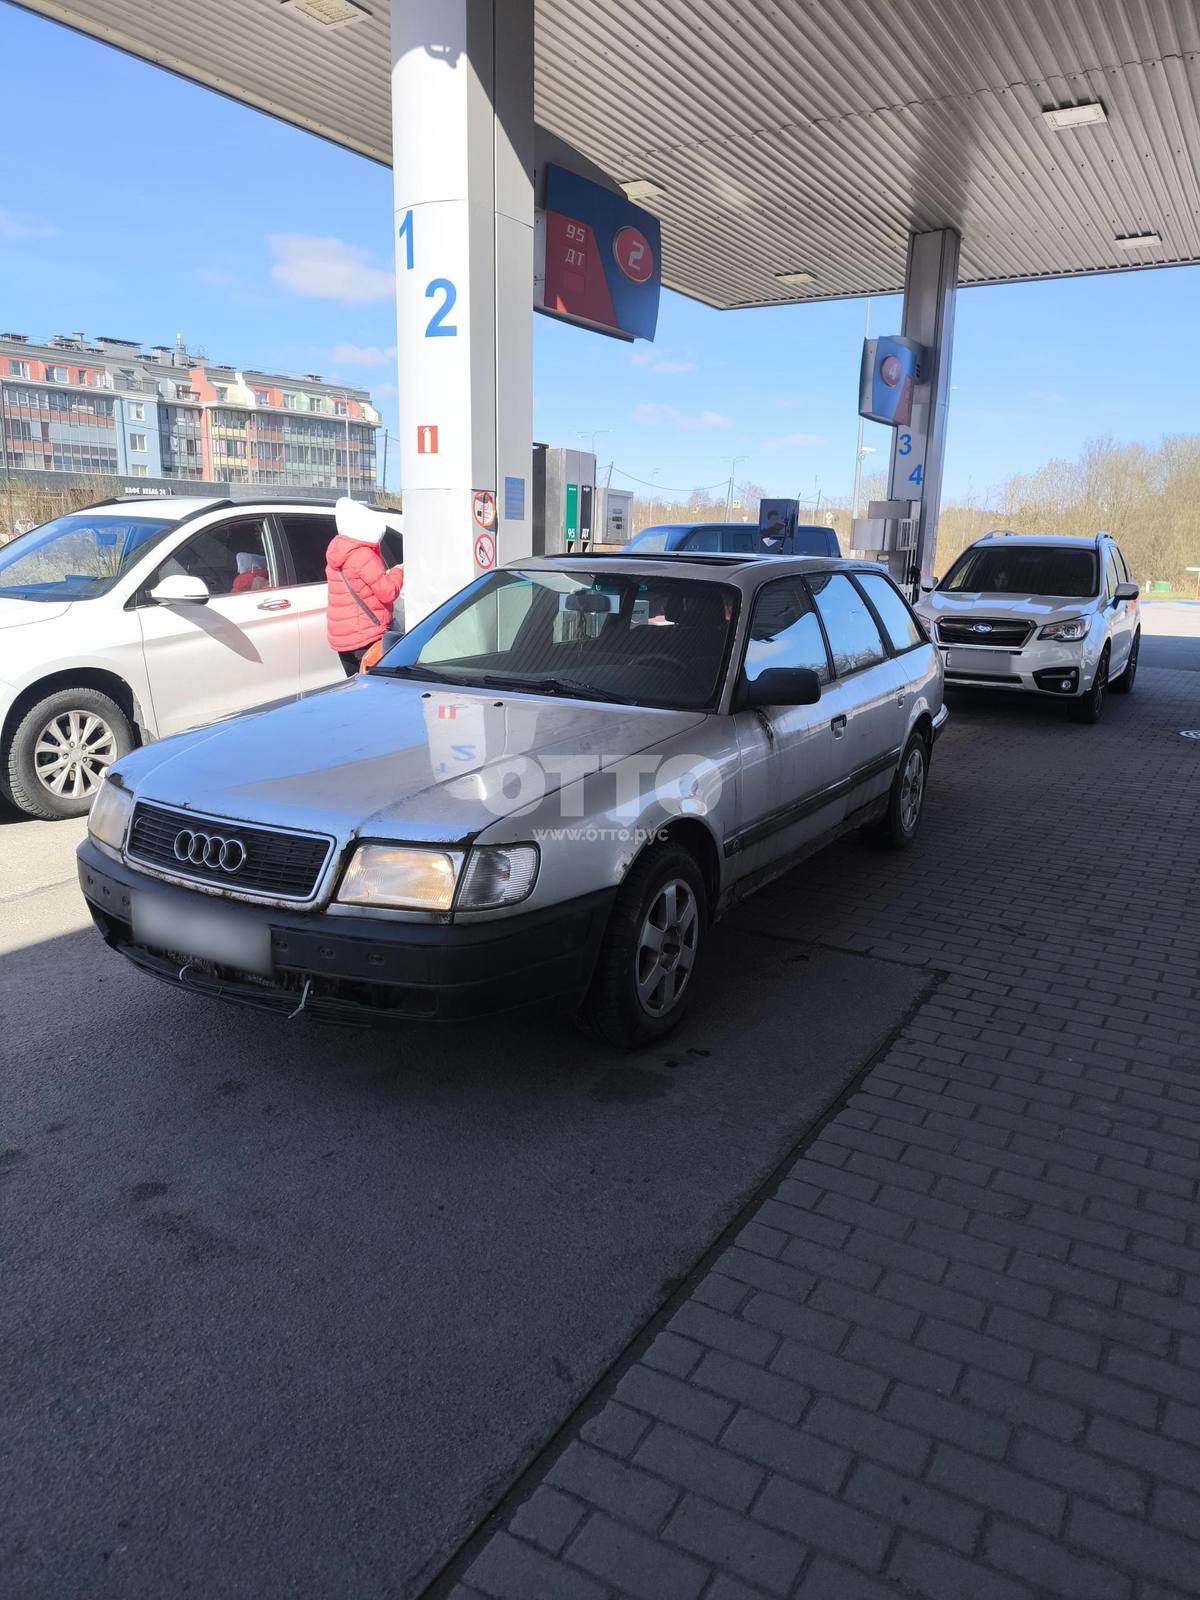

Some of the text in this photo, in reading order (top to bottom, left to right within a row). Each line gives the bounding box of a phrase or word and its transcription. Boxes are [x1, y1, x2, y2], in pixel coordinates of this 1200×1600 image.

[399, 209, 415, 270] 1
[566, 223, 586, 242] 95
[565, 248, 585, 266] ДТ
[628, 240, 645, 270] 2
[425, 277, 458, 338] 2
[888, 363, 897, 379] 4
[899, 434, 912, 455] 3
[909, 464, 923, 485] 4
[568, 528, 576, 538] 95
[581, 528, 589, 539] ДТ
